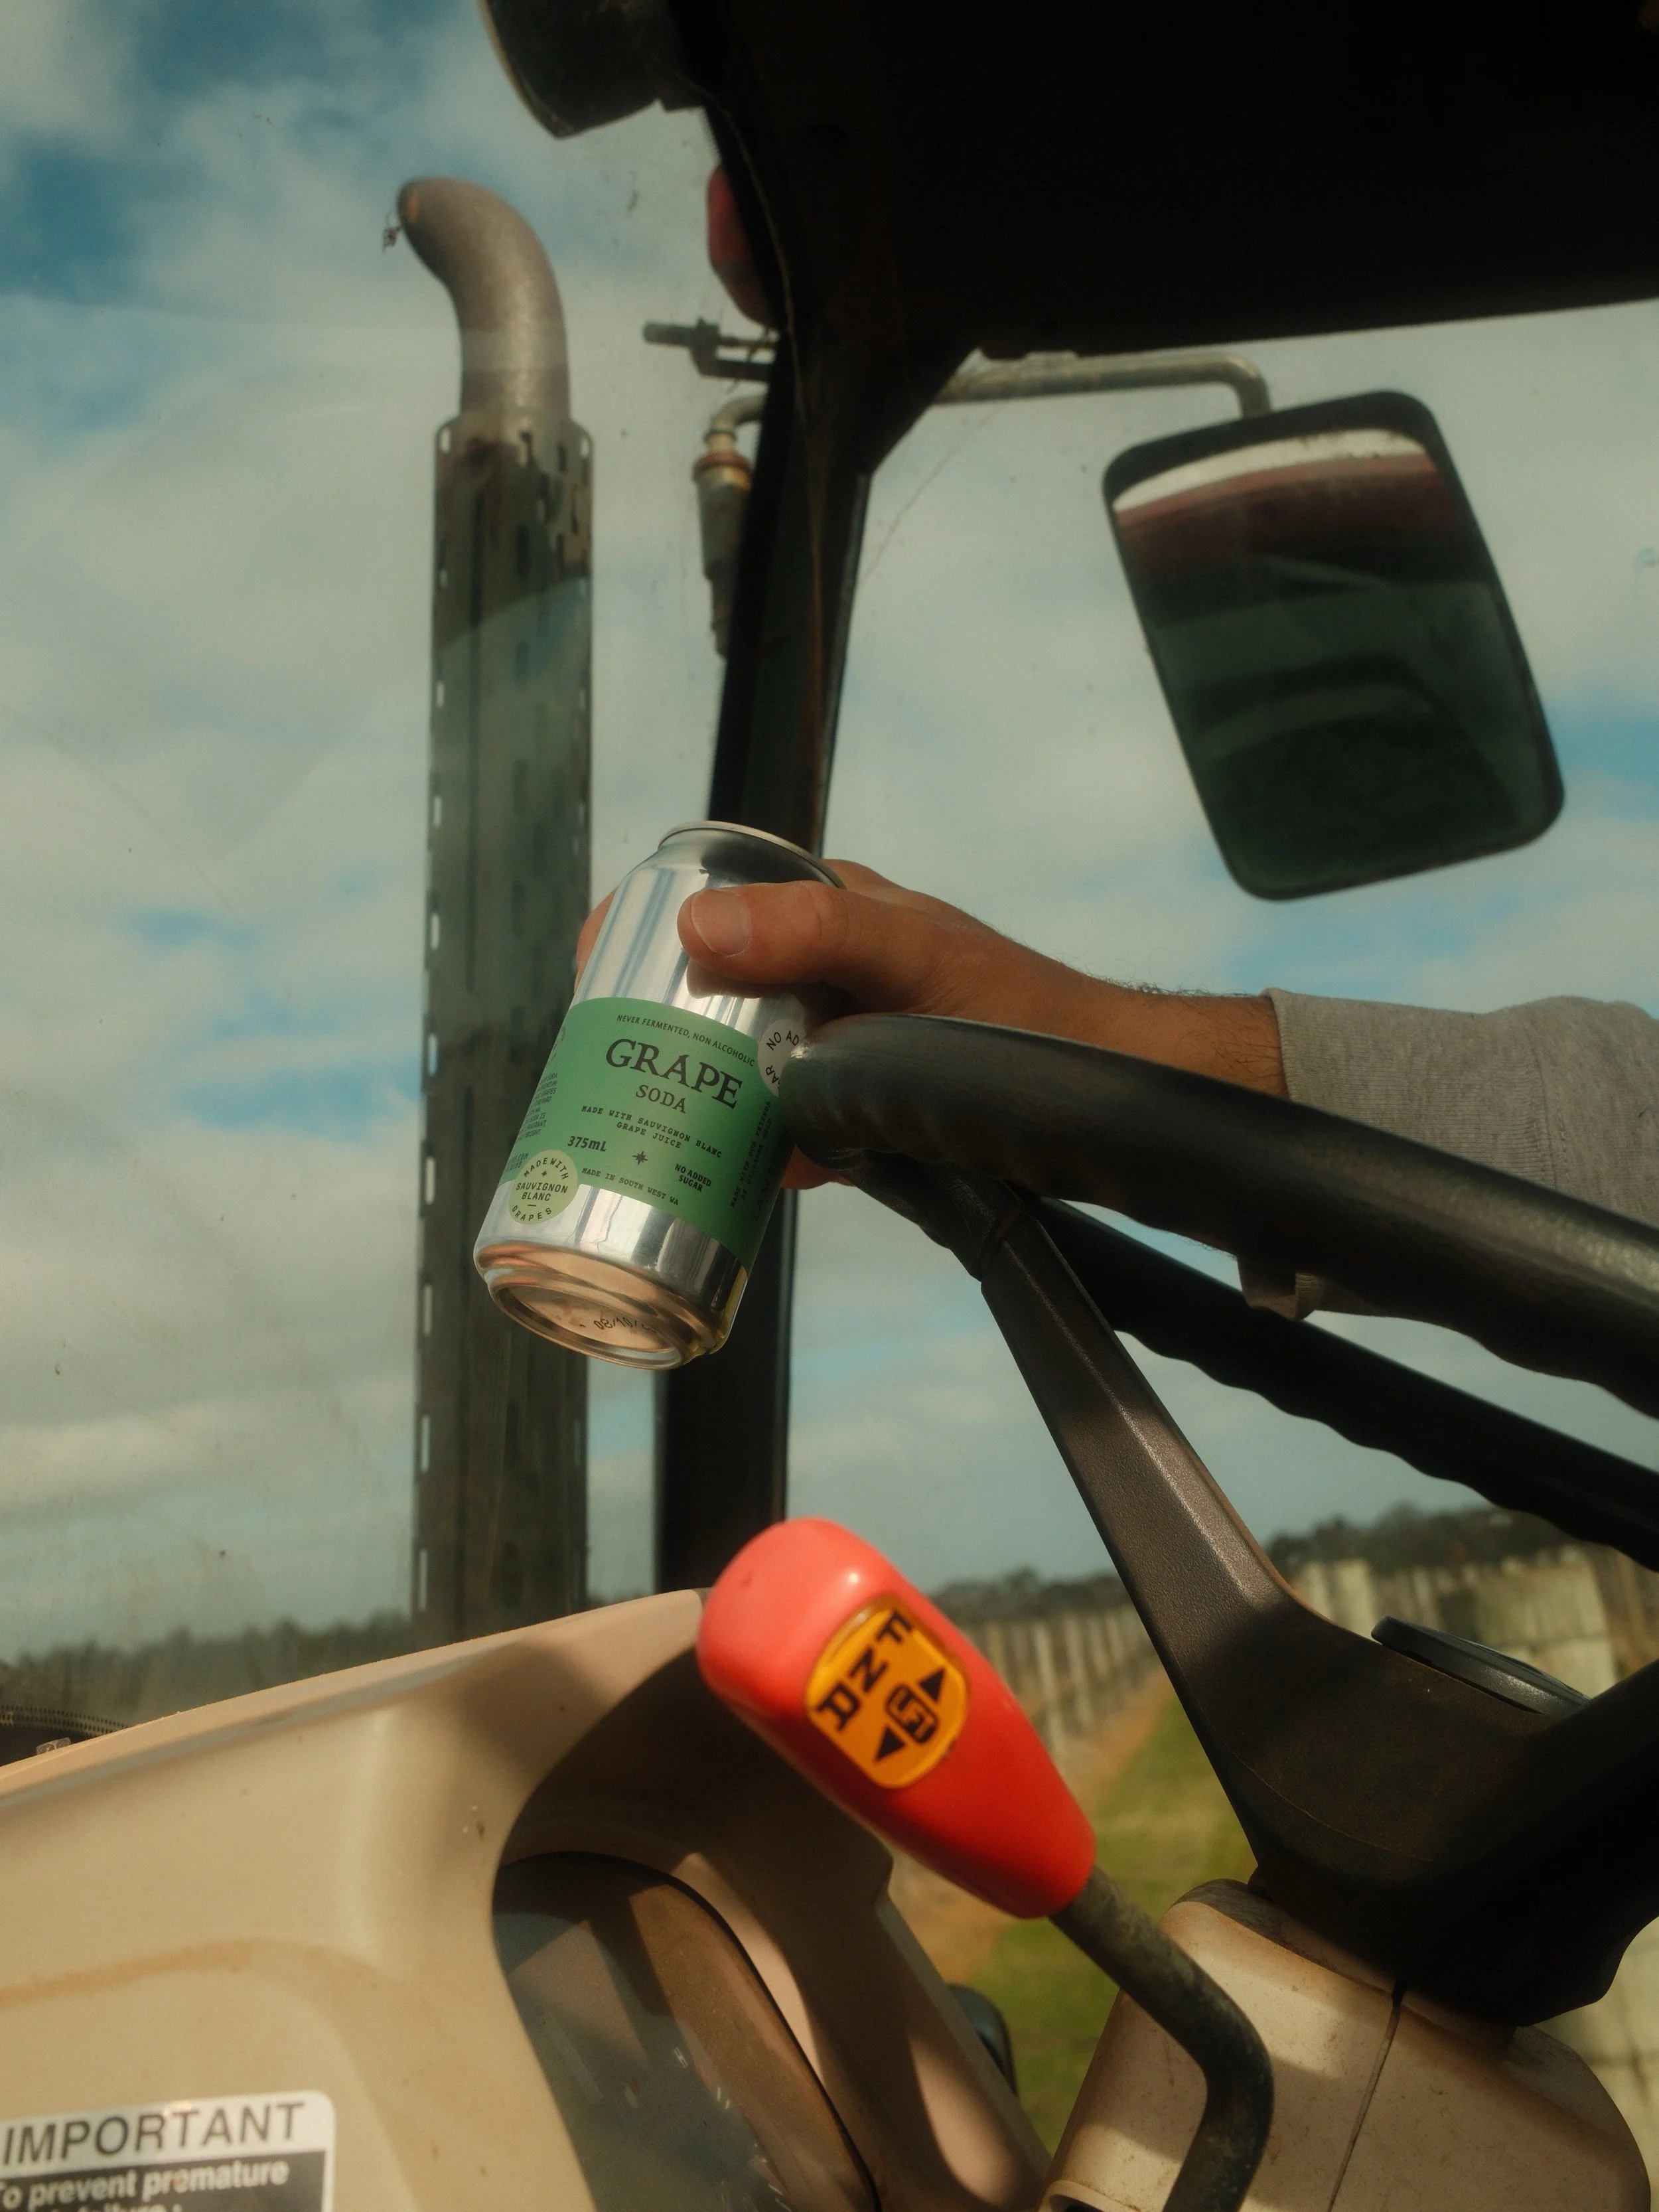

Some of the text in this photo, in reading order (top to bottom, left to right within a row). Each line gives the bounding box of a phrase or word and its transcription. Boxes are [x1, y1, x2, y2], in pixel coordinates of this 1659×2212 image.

[616, 1015, 755, 1067] NEVER FERMENTED, NON ALCOHOLIC
[766, 1031, 782, 1051] NO
[605, 1038, 743, 1110] GRAPE
[636, 1084, 687, 1114] SODA
[567, 1136, 607, 1152] 375mL
[581, 1105, 722, 1158] MADE WITH SAUVIGNON BLANC
[616, 1122, 682, 1149] GRAPE JUICE
[524, 1157, 548, 1177] MADE
[550, 1157, 569, 1179] WITH
[675, 1163, 711, 1187] NO ADDED
[516, 1183, 569, 1193] SAUVIGNON
[522, 1192, 551, 1201] BLANC
[582, 1167, 680, 1206] MADE IN SOUTH WEST WA
[678, 1175, 703, 1192] SUGAR
[512, 1205, 552, 1221] GRAPES
[875, 1609, 912, 1644] F
[847, 1646, 889, 1693] N
[815, 1682, 861, 1732] R
[3, 2101, 305, 2166] IMPORTANT
[27, 2169, 138, 2212] prevent
[142, 2160, 290, 2202] premature
